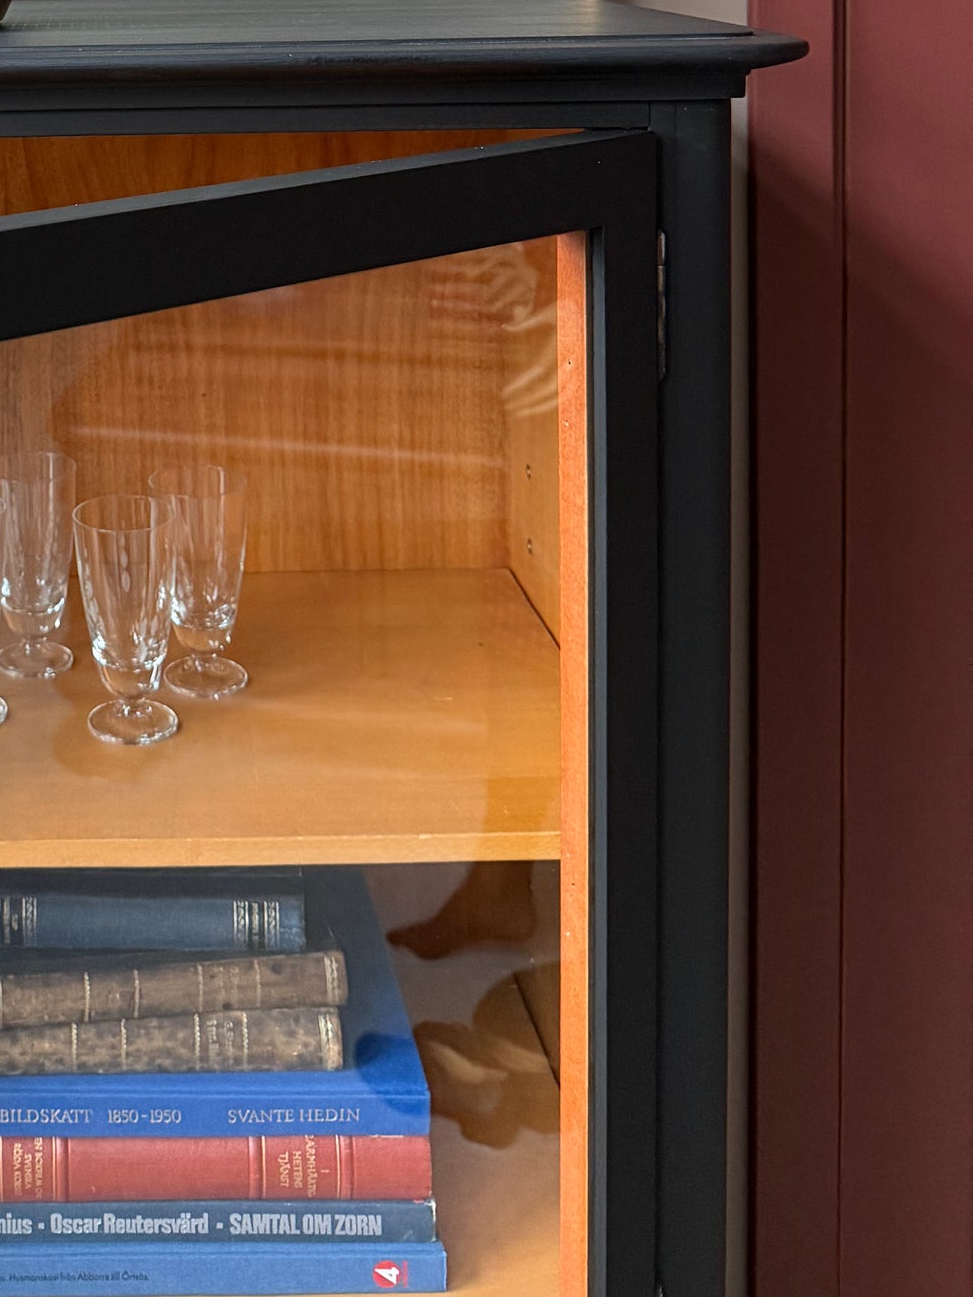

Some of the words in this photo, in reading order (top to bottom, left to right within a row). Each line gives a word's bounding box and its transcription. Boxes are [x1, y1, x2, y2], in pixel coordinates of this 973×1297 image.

[0, 1109, 93, 1124] BILDSKATT
[228, 1109, 294, 1123] SVANTE
[299, 1109, 360, 1122] HEDIN
[278, 1151, 290, 1188] TJÄNST
[292, 1151, 303, 1189] HETENS
[50, 1213, 101, 1234] Oscar
[103, 1213, 209, 1234] Reutersvärd
[229, 1213, 301, 1235] SAMTAL
[302, 1214, 331, 1235] OM
[334, 1214, 382, 1236] ZORN
